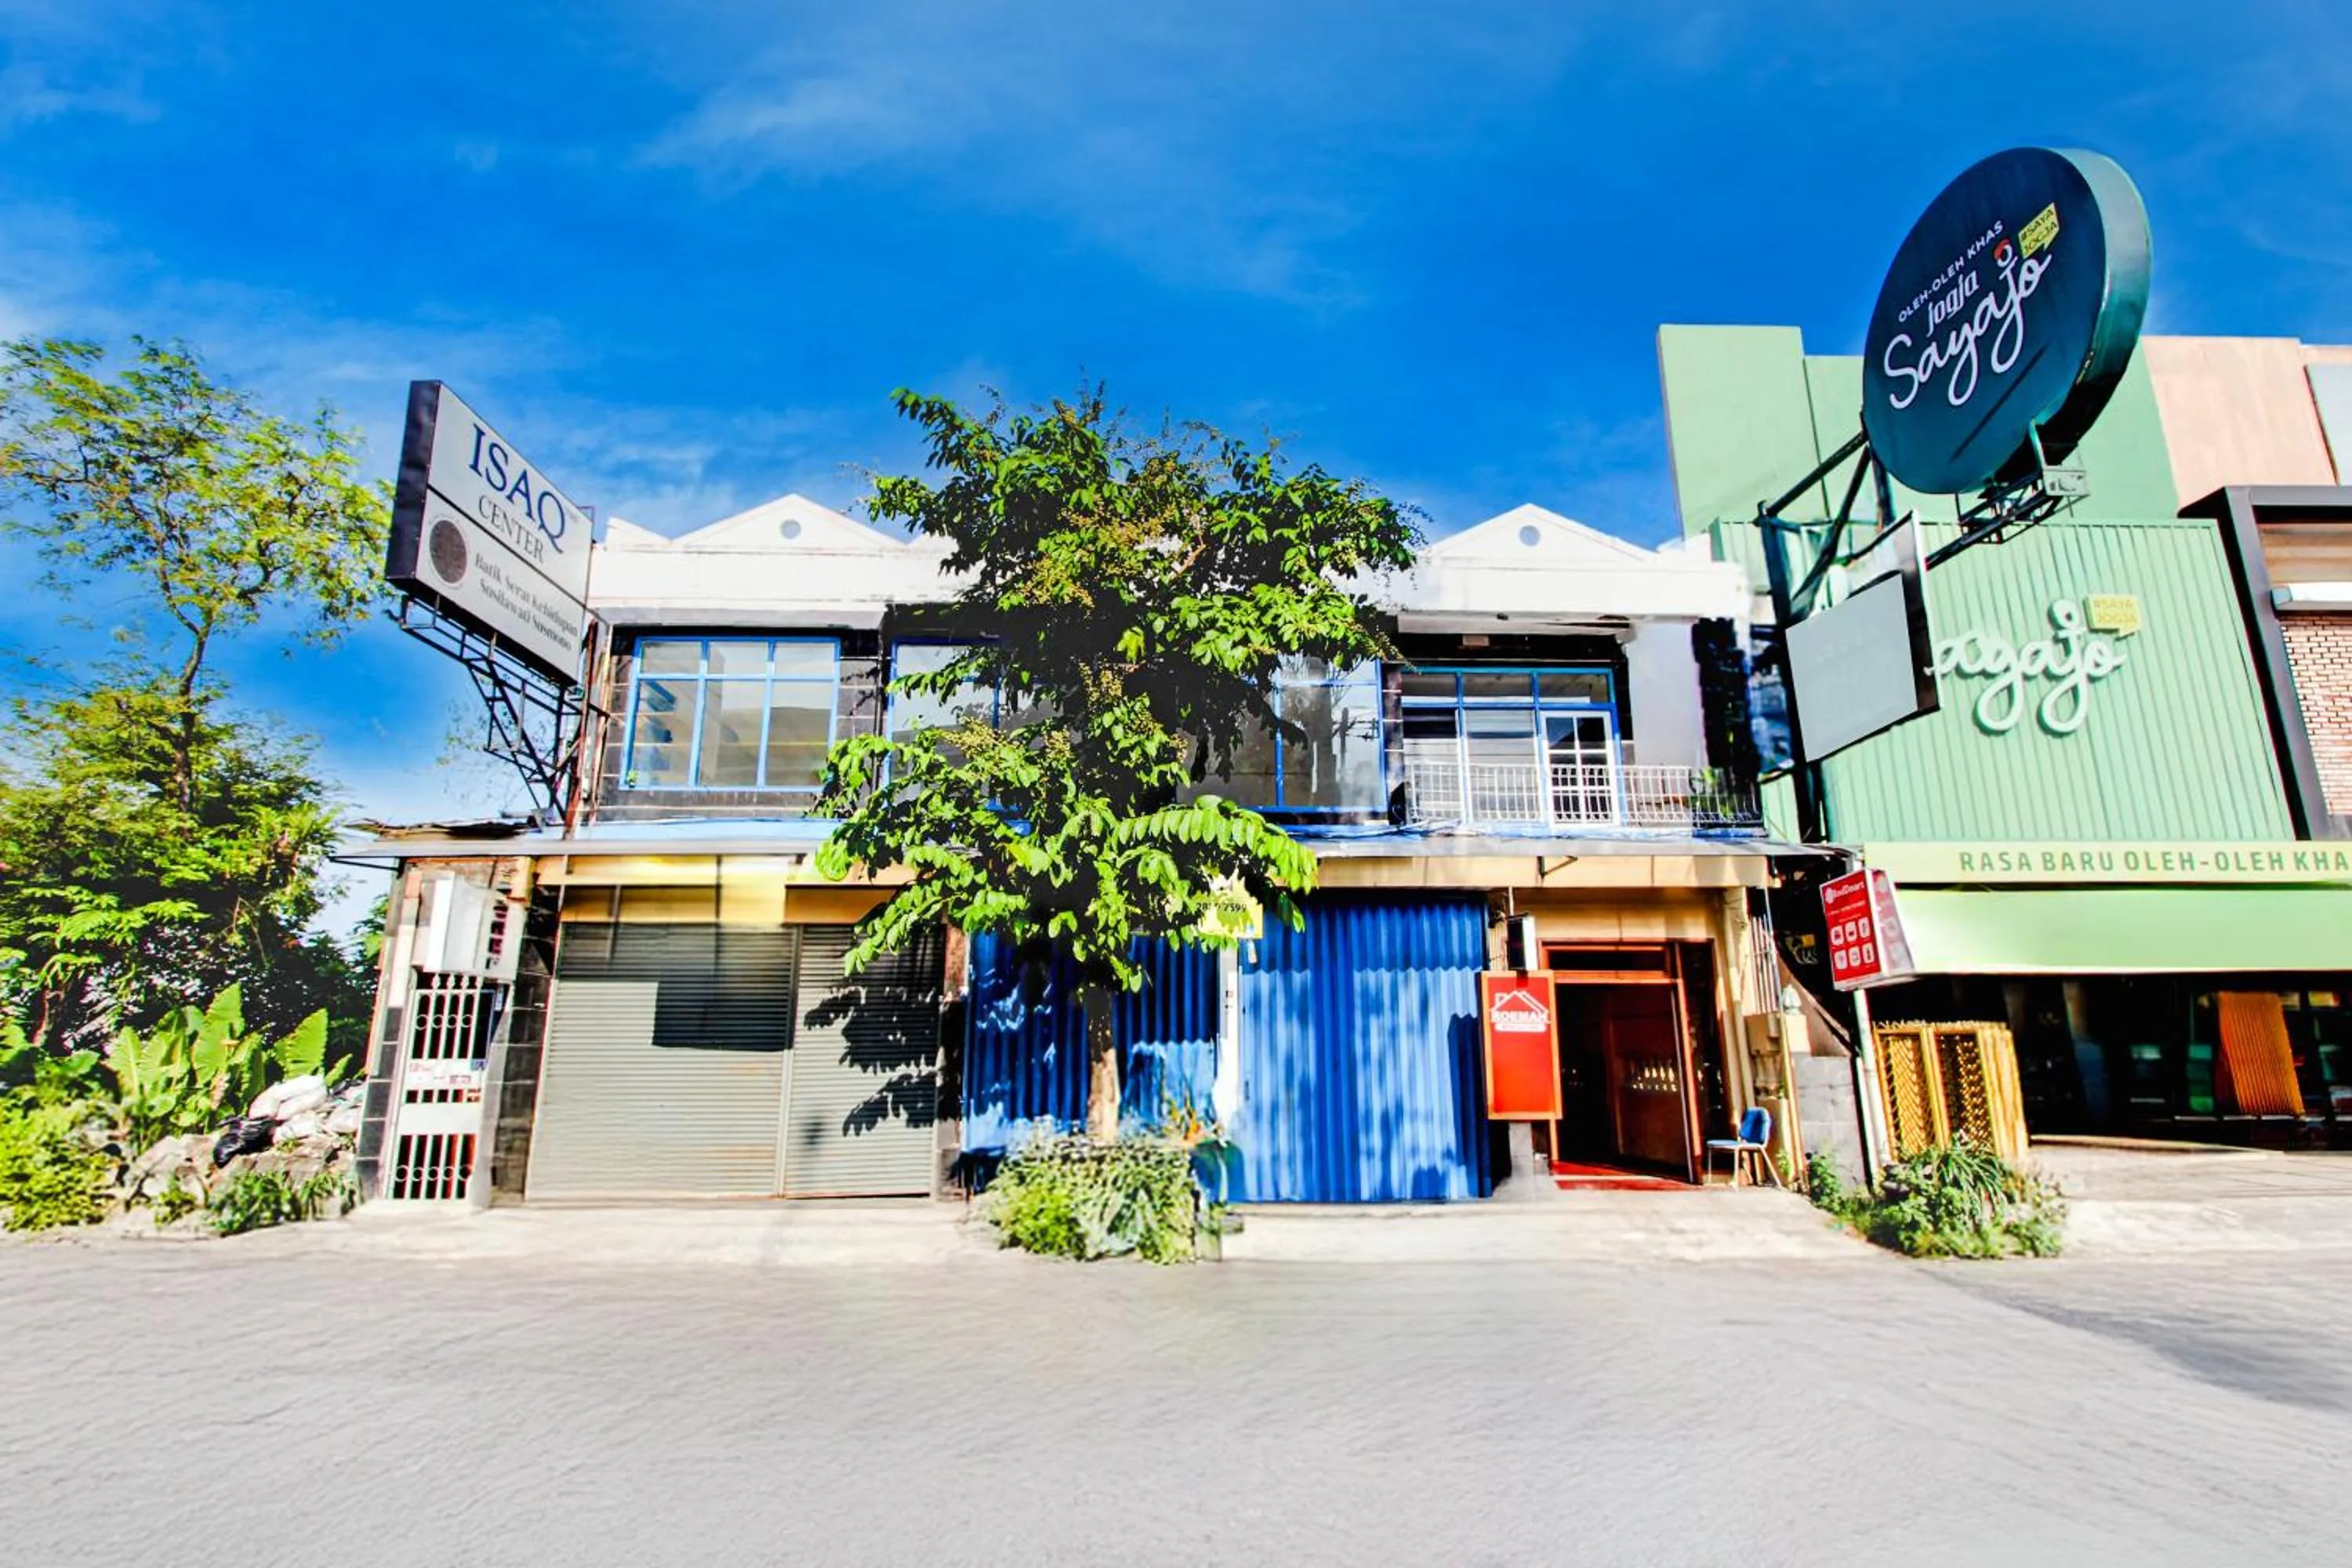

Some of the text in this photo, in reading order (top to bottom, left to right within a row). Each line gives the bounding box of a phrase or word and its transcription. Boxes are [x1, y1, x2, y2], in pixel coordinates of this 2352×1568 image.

[1898, 220, 2004, 322] OLEH-OLEH KHAS
[1884, 238, 2053, 409] Sayajo
[468, 423, 567, 554] ISAQ
[478, 495, 545, 564] CENTER
[1959, 851, 2033, 872] RASA
[2041, 851, 2114, 872] BARU
[2123, 851, 2285, 872] OLEH-OLEH
